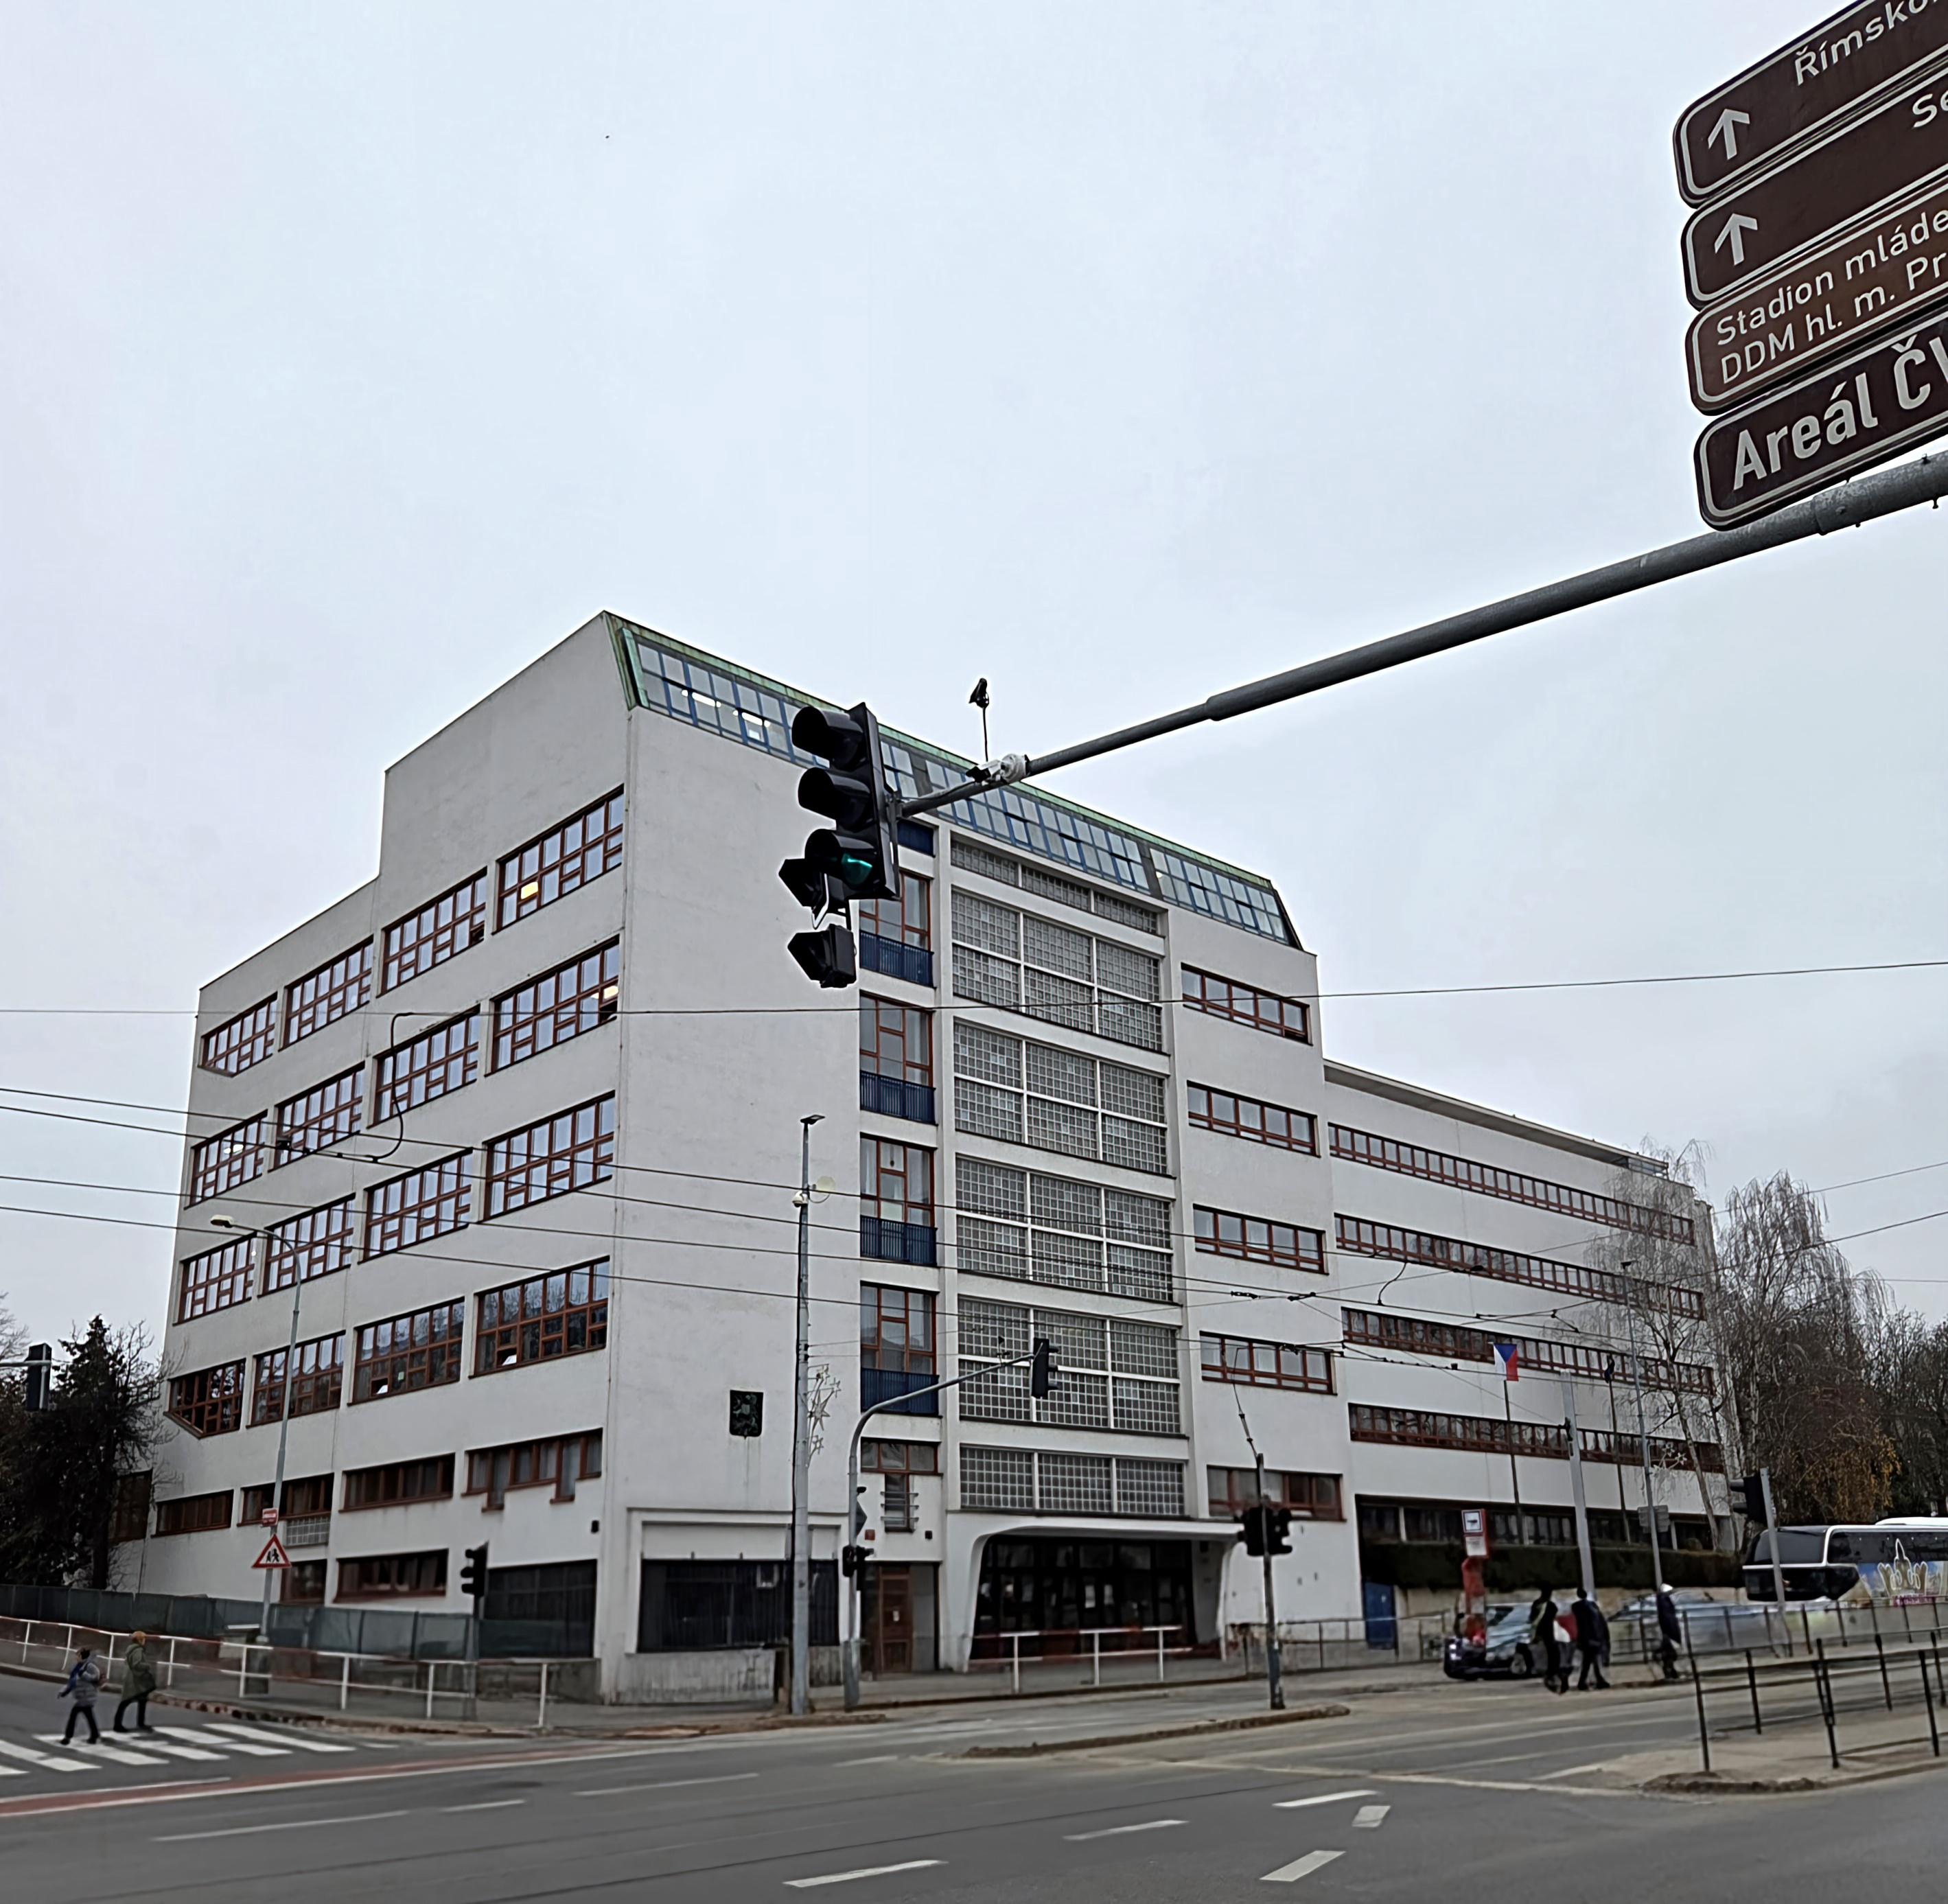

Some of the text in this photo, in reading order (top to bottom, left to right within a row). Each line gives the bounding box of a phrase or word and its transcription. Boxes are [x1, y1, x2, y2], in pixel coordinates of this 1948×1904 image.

[1794, 0, 1937, 86] Římsko
[1717, 210, 1948, 345] Stadion mláde
[1721, 252, 1947, 384] DDM hl. m. Pr
[1733, 373, 1879, 490] Areál
